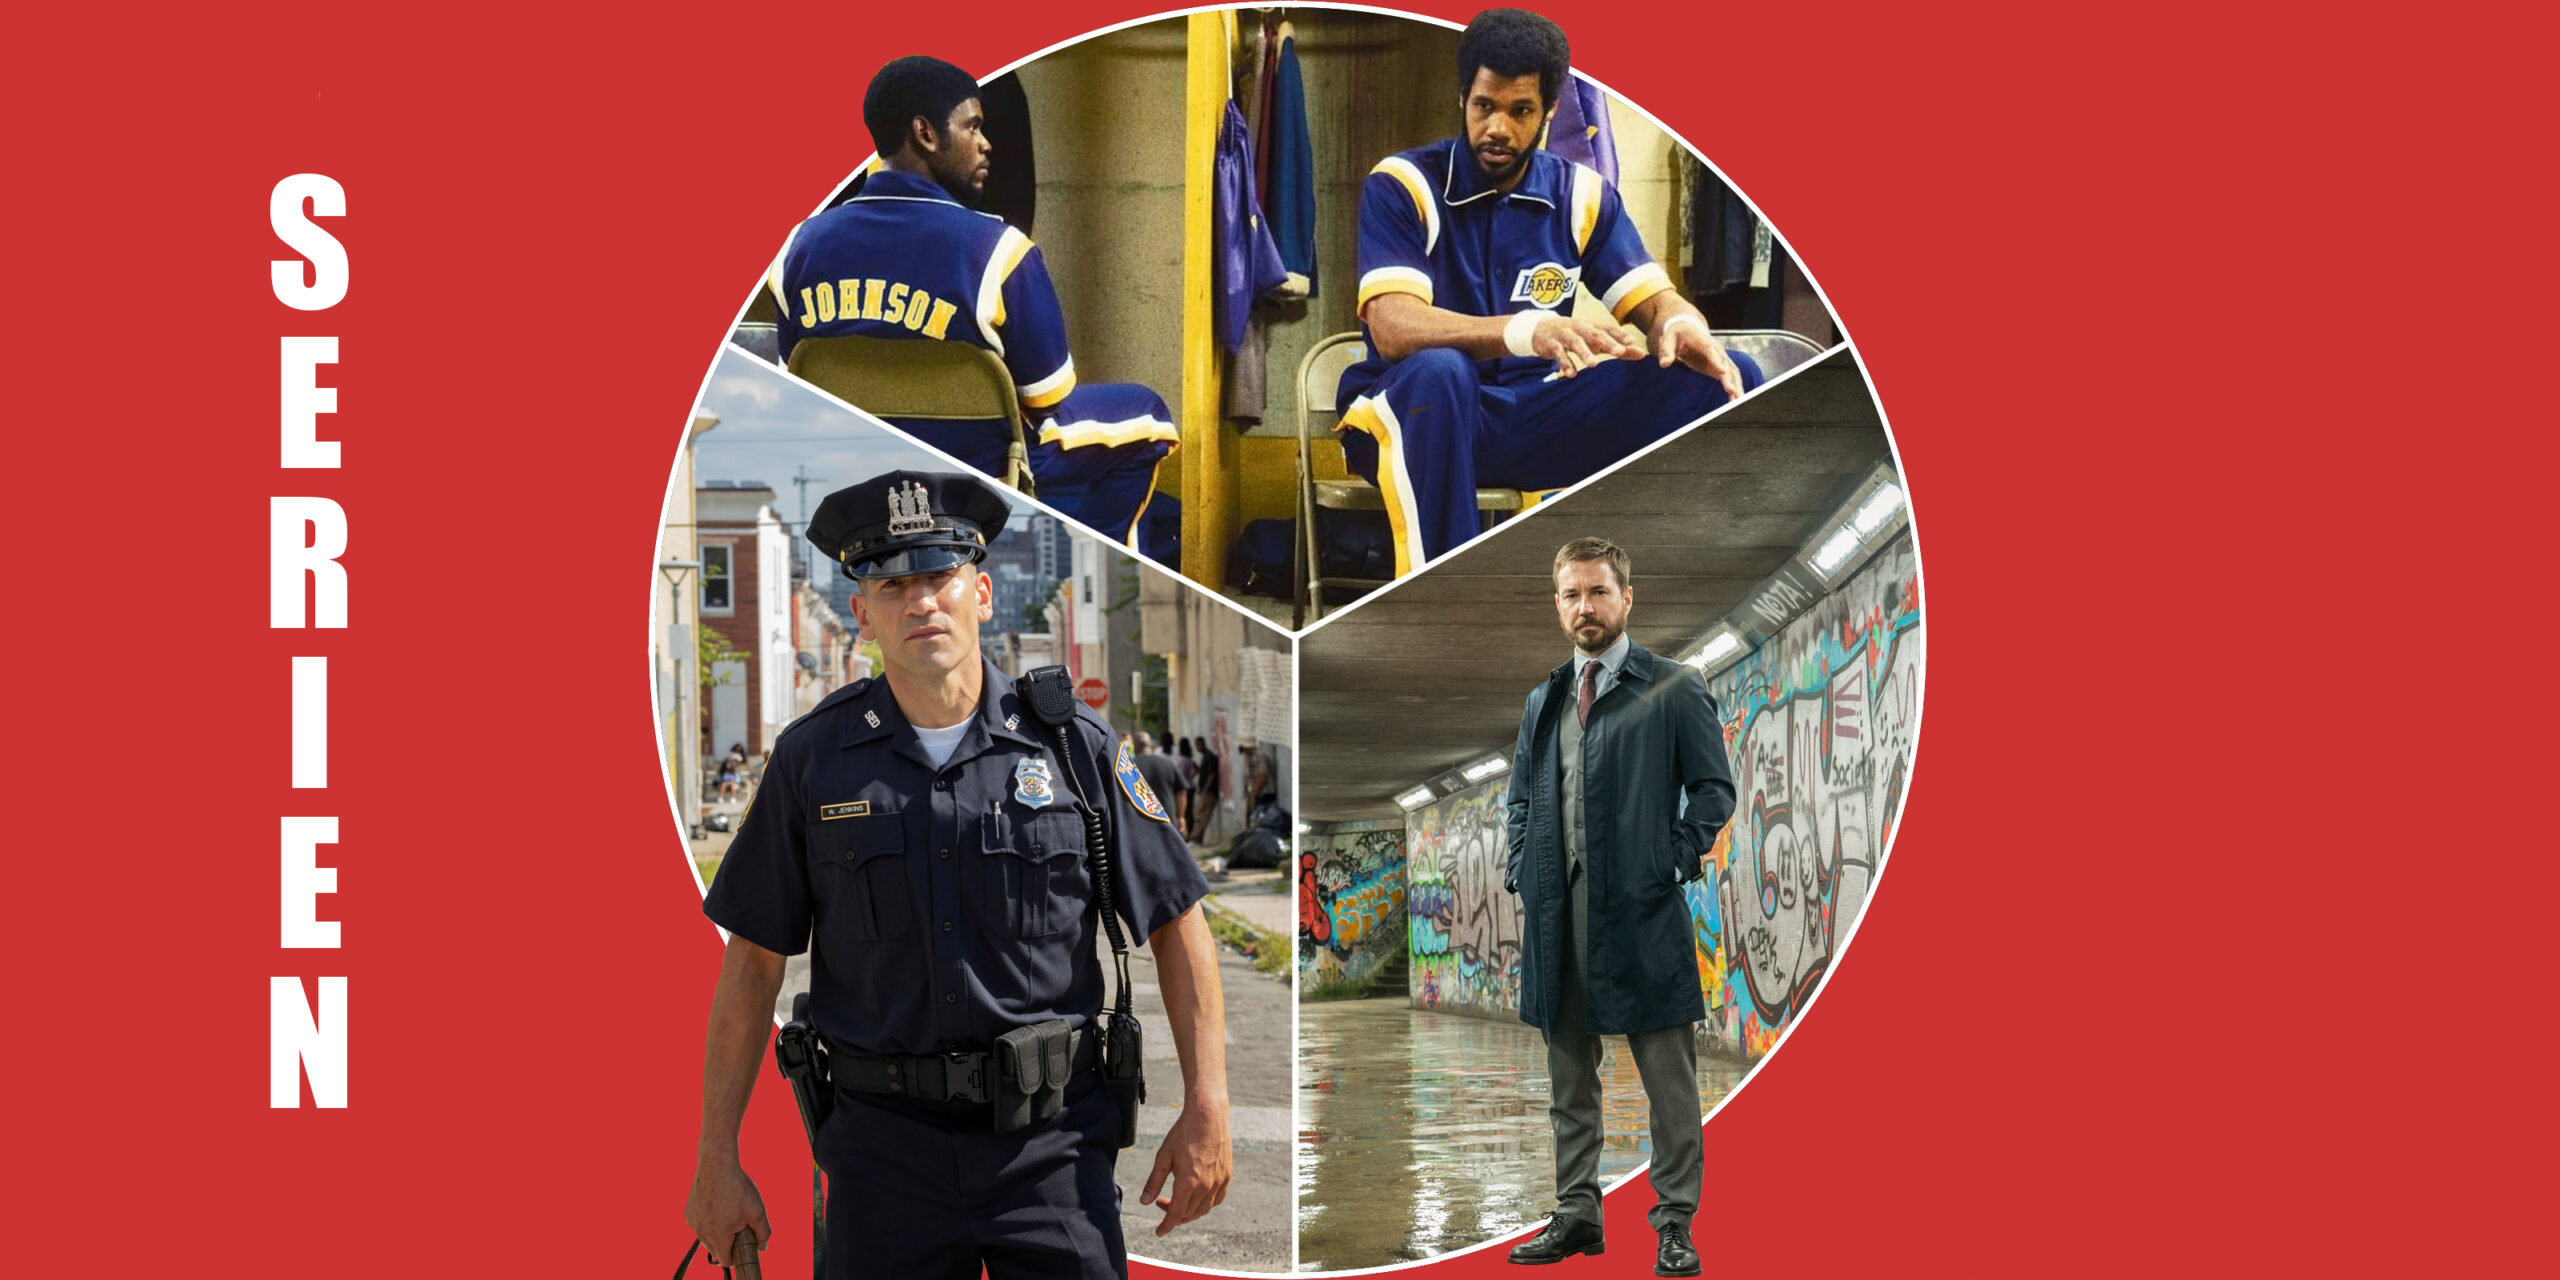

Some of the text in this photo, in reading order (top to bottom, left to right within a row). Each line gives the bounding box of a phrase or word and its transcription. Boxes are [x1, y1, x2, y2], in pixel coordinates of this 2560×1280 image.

[1518, 274, 1574, 297] LAKERS
[801, 278, 957, 341] JOHNSON
[1080, 686, 1107, 700] STOP
[838, 804, 864, 814] JENKINS
